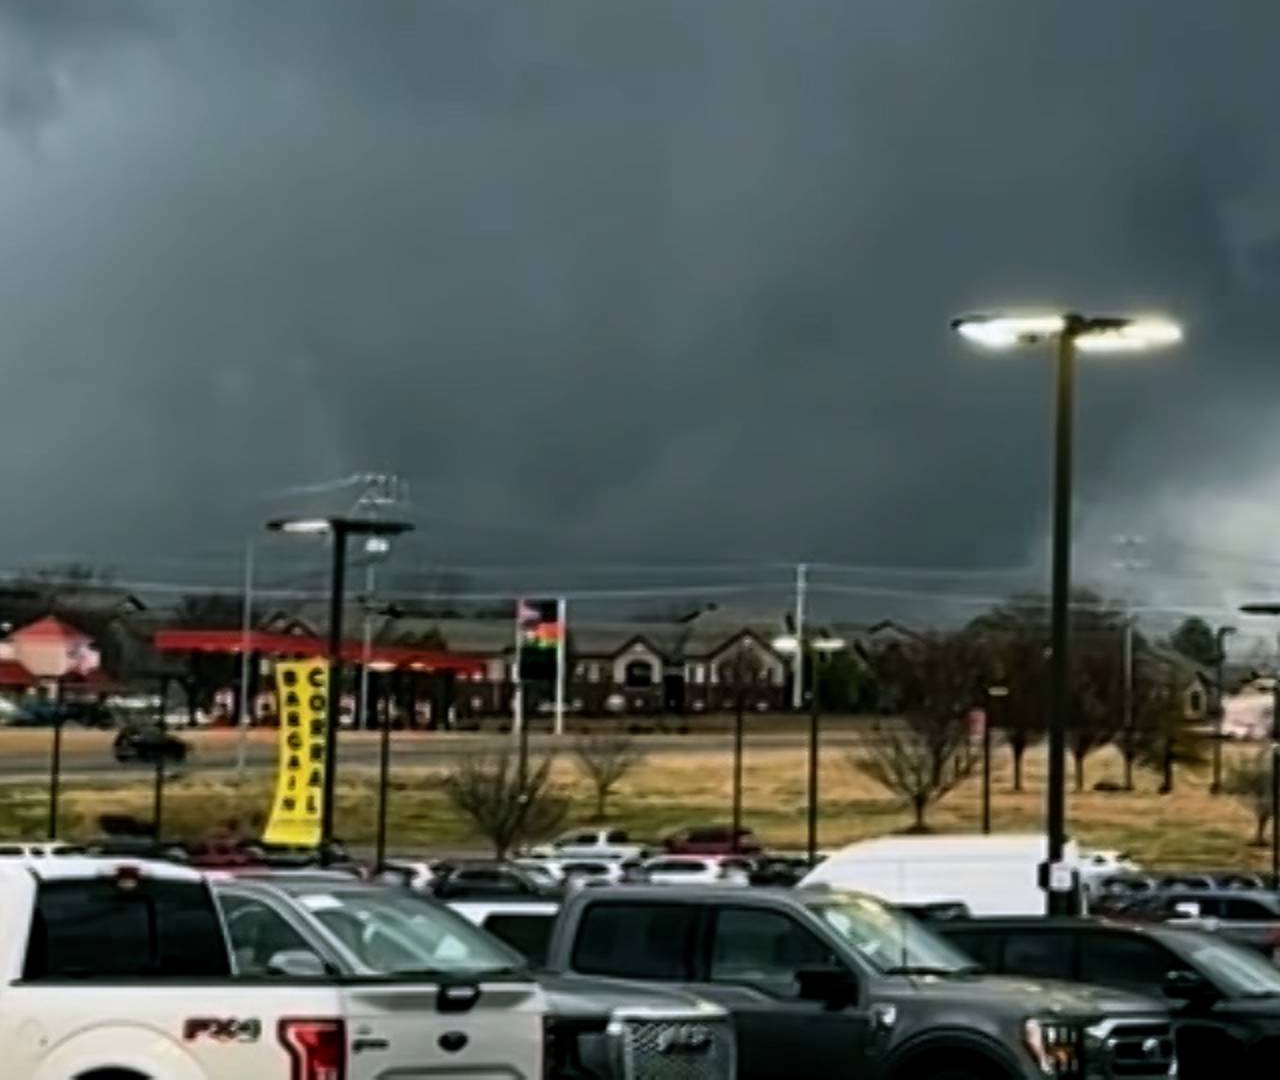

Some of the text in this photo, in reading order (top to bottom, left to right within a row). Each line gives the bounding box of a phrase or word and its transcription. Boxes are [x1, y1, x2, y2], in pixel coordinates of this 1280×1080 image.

[280, 670, 301, 812] BARGAIN
[306, 667, 325, 814] CORRAL
[183, 1018, 261, 1043] FX4
